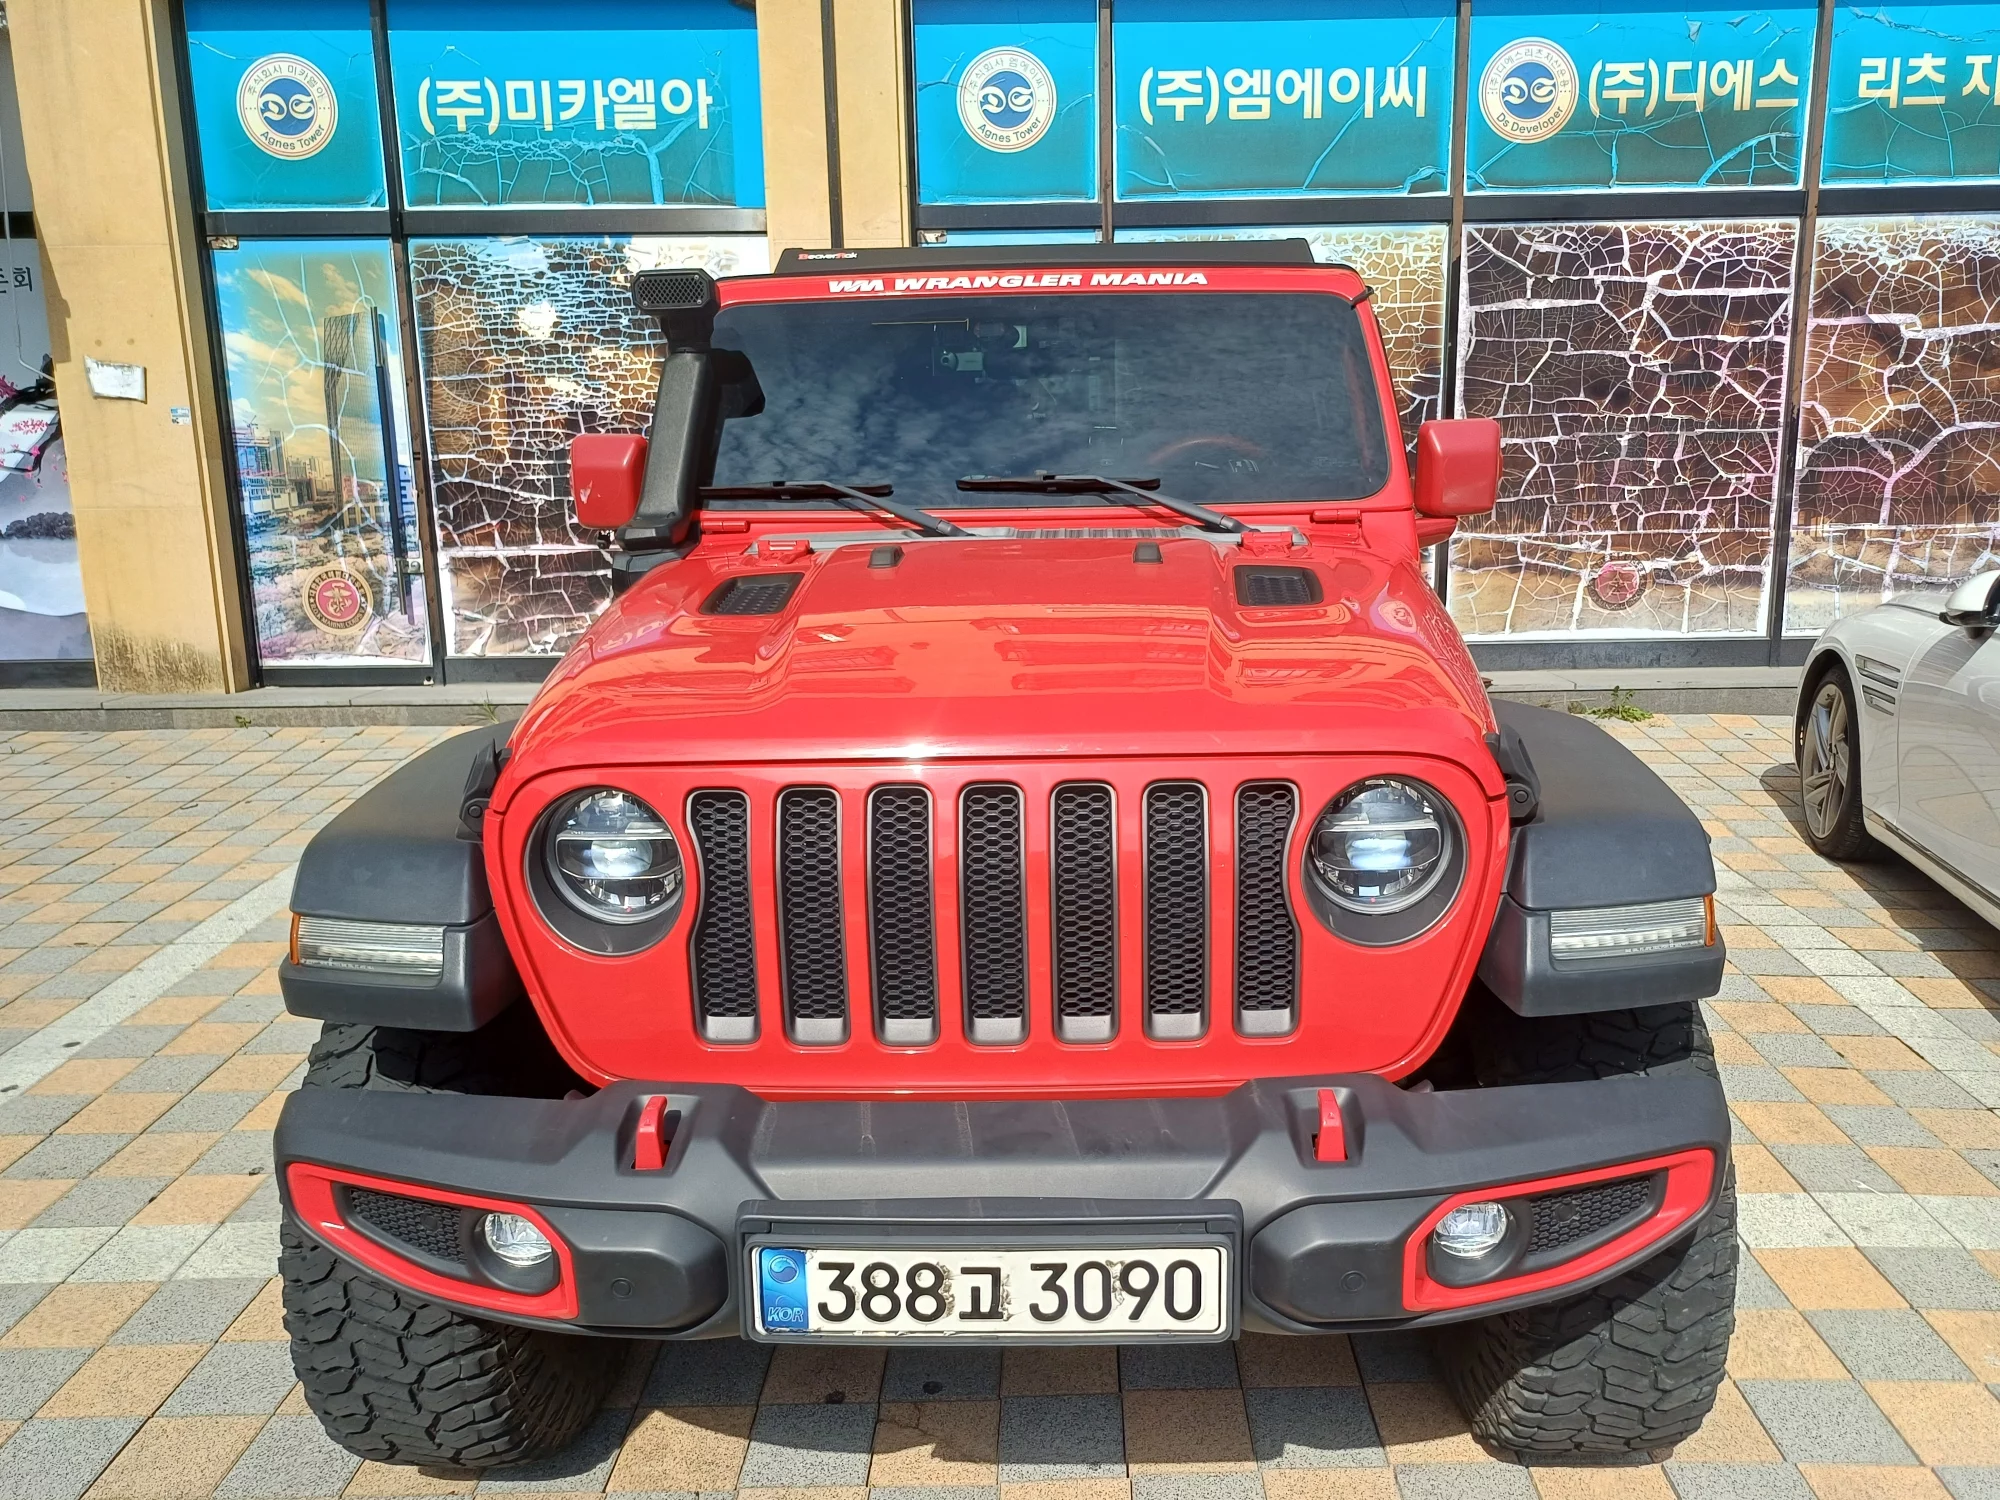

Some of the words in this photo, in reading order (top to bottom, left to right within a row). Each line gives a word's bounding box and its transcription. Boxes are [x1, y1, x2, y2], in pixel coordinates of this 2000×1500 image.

[1138, 65, 1427, 126] (주)엠에이씨
[1588, 58, 1799, 118] (주)디에스
[1857, 53, 1946, 109] 리츠
[417, 76, 714, 136] (주)미카엘아
[1496, 112, 1510, 128] Ds
[1510, 105, 1564, 134] Developer
[260, 130, 296, 150] Agnes
[297, 124, 325, 148] Tower
[977, 123, 1011, 143] Agnes
[1012, 116, 1042, 141] Tower
[828, 279, 885, 293] WM
[893, 273, 1083, 292] WRANGLER
[1089, 272, 1209, 287] MANIA
[816, 1260, 1004, 1323] 388고
[1028, 1259, 1203, 1323] 3090
[767, 1306, 805, 1323] KOR
